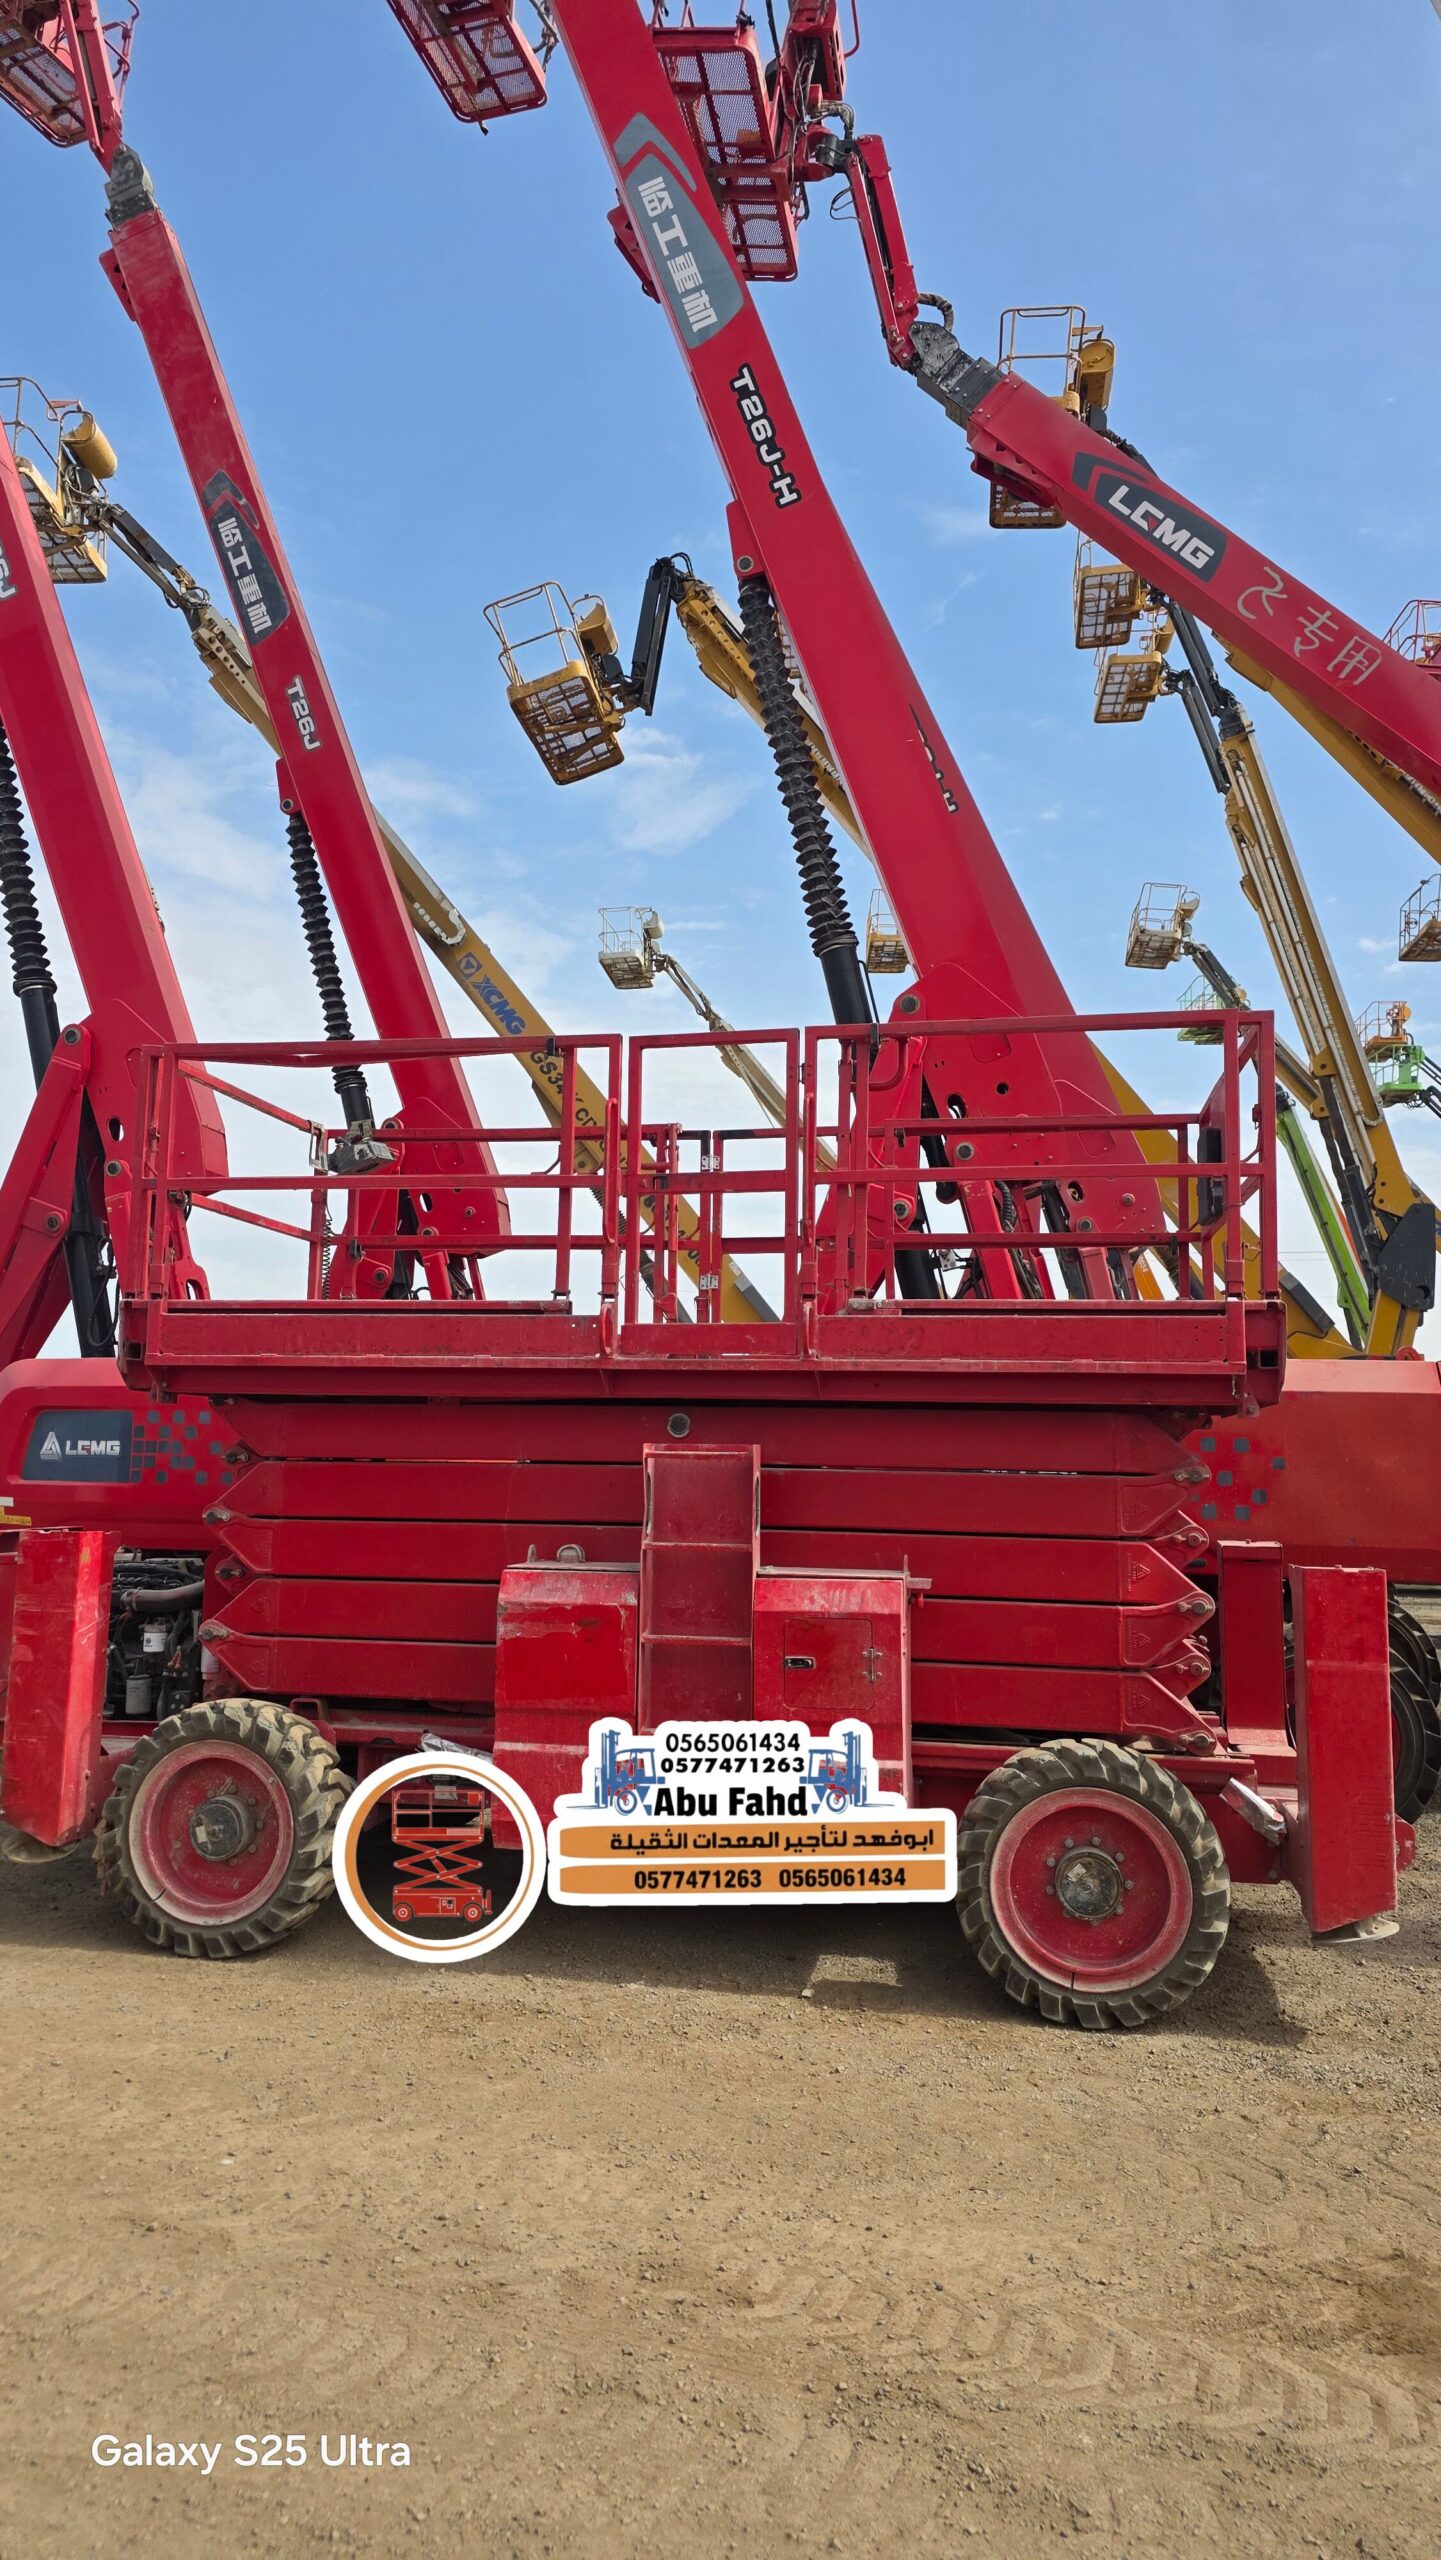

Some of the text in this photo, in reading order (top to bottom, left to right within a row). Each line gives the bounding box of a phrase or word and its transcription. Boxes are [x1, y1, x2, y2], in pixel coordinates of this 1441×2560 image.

[638, 176, 718, 333] 临工重机
[733, 366, 799, 506] T26J-H
[217, 517, 272, 634] 临工重机
[287, 677, 321, 750] T26J
[471, 974, 526, 1035] XCMG
